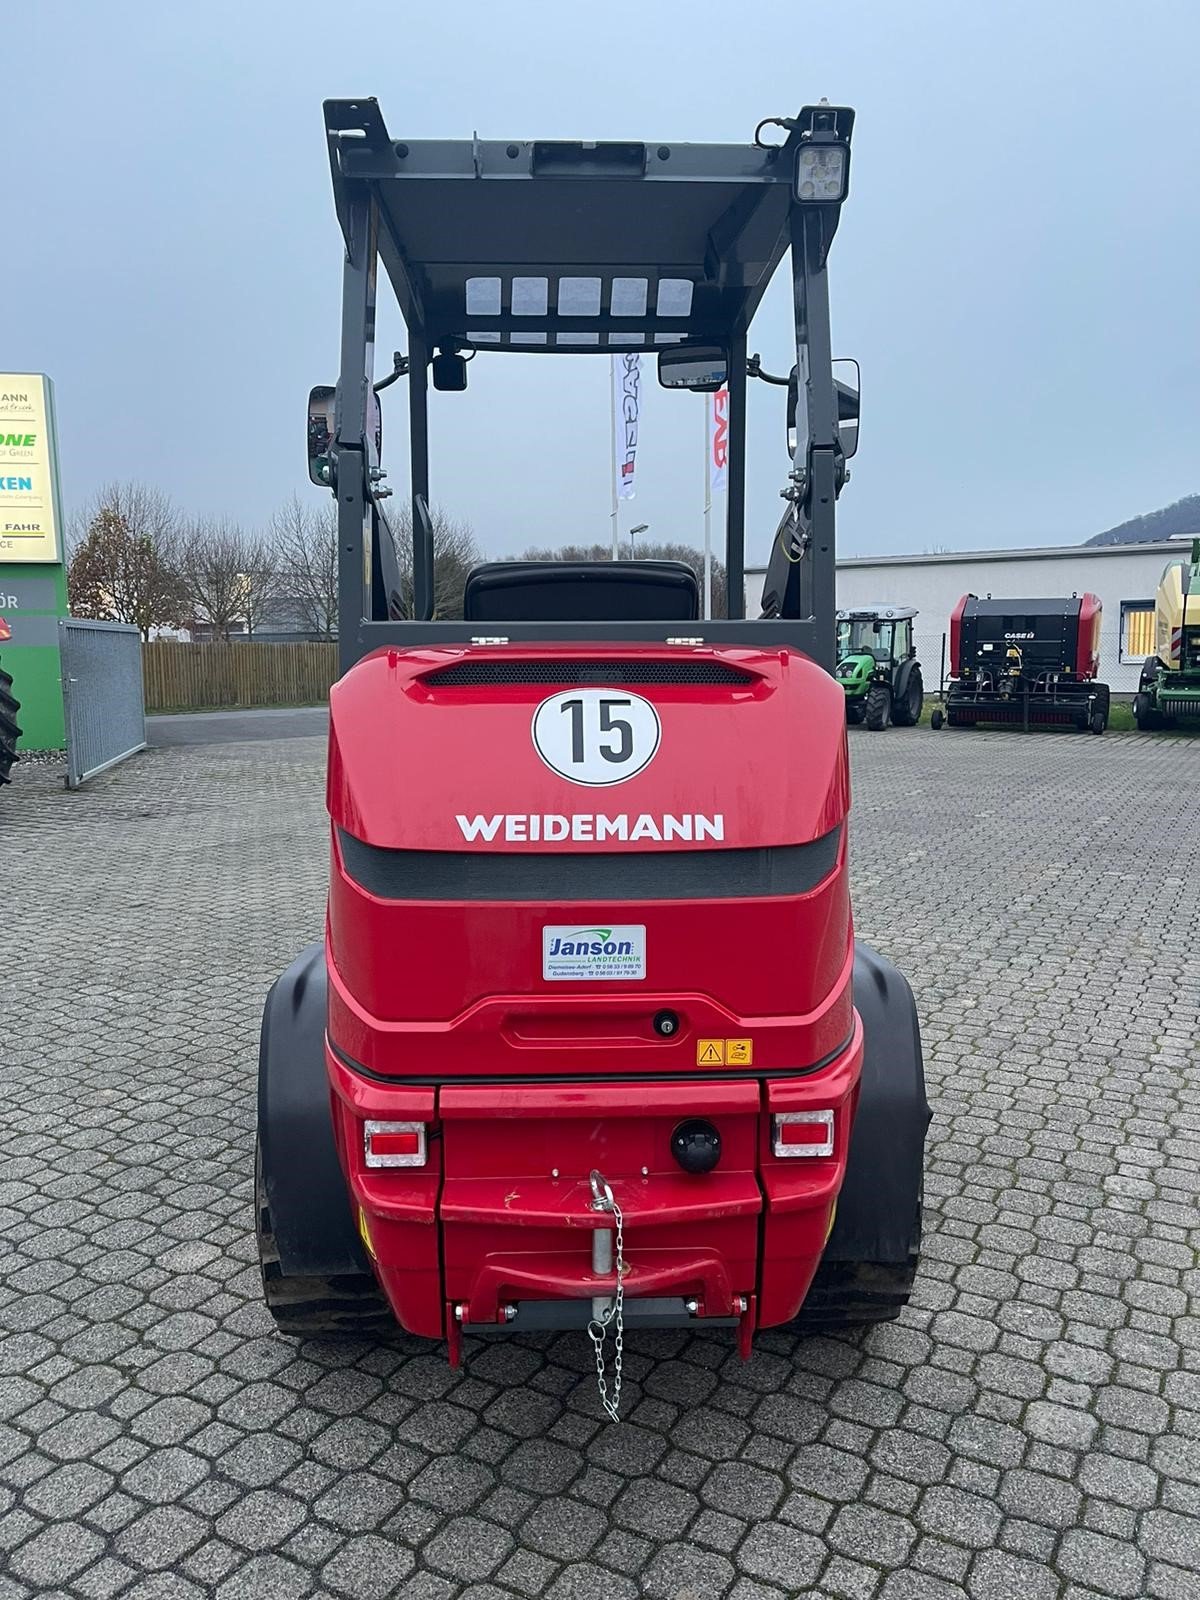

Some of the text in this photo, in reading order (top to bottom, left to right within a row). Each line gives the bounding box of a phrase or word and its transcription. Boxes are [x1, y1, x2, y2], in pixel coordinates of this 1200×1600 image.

[5, 523, 41, 531] FAHR
[560, 699, 634, 763] 15
[455, 814, 725, 842] WEIDEMANN
[549, 938, 632, 956] Janson
